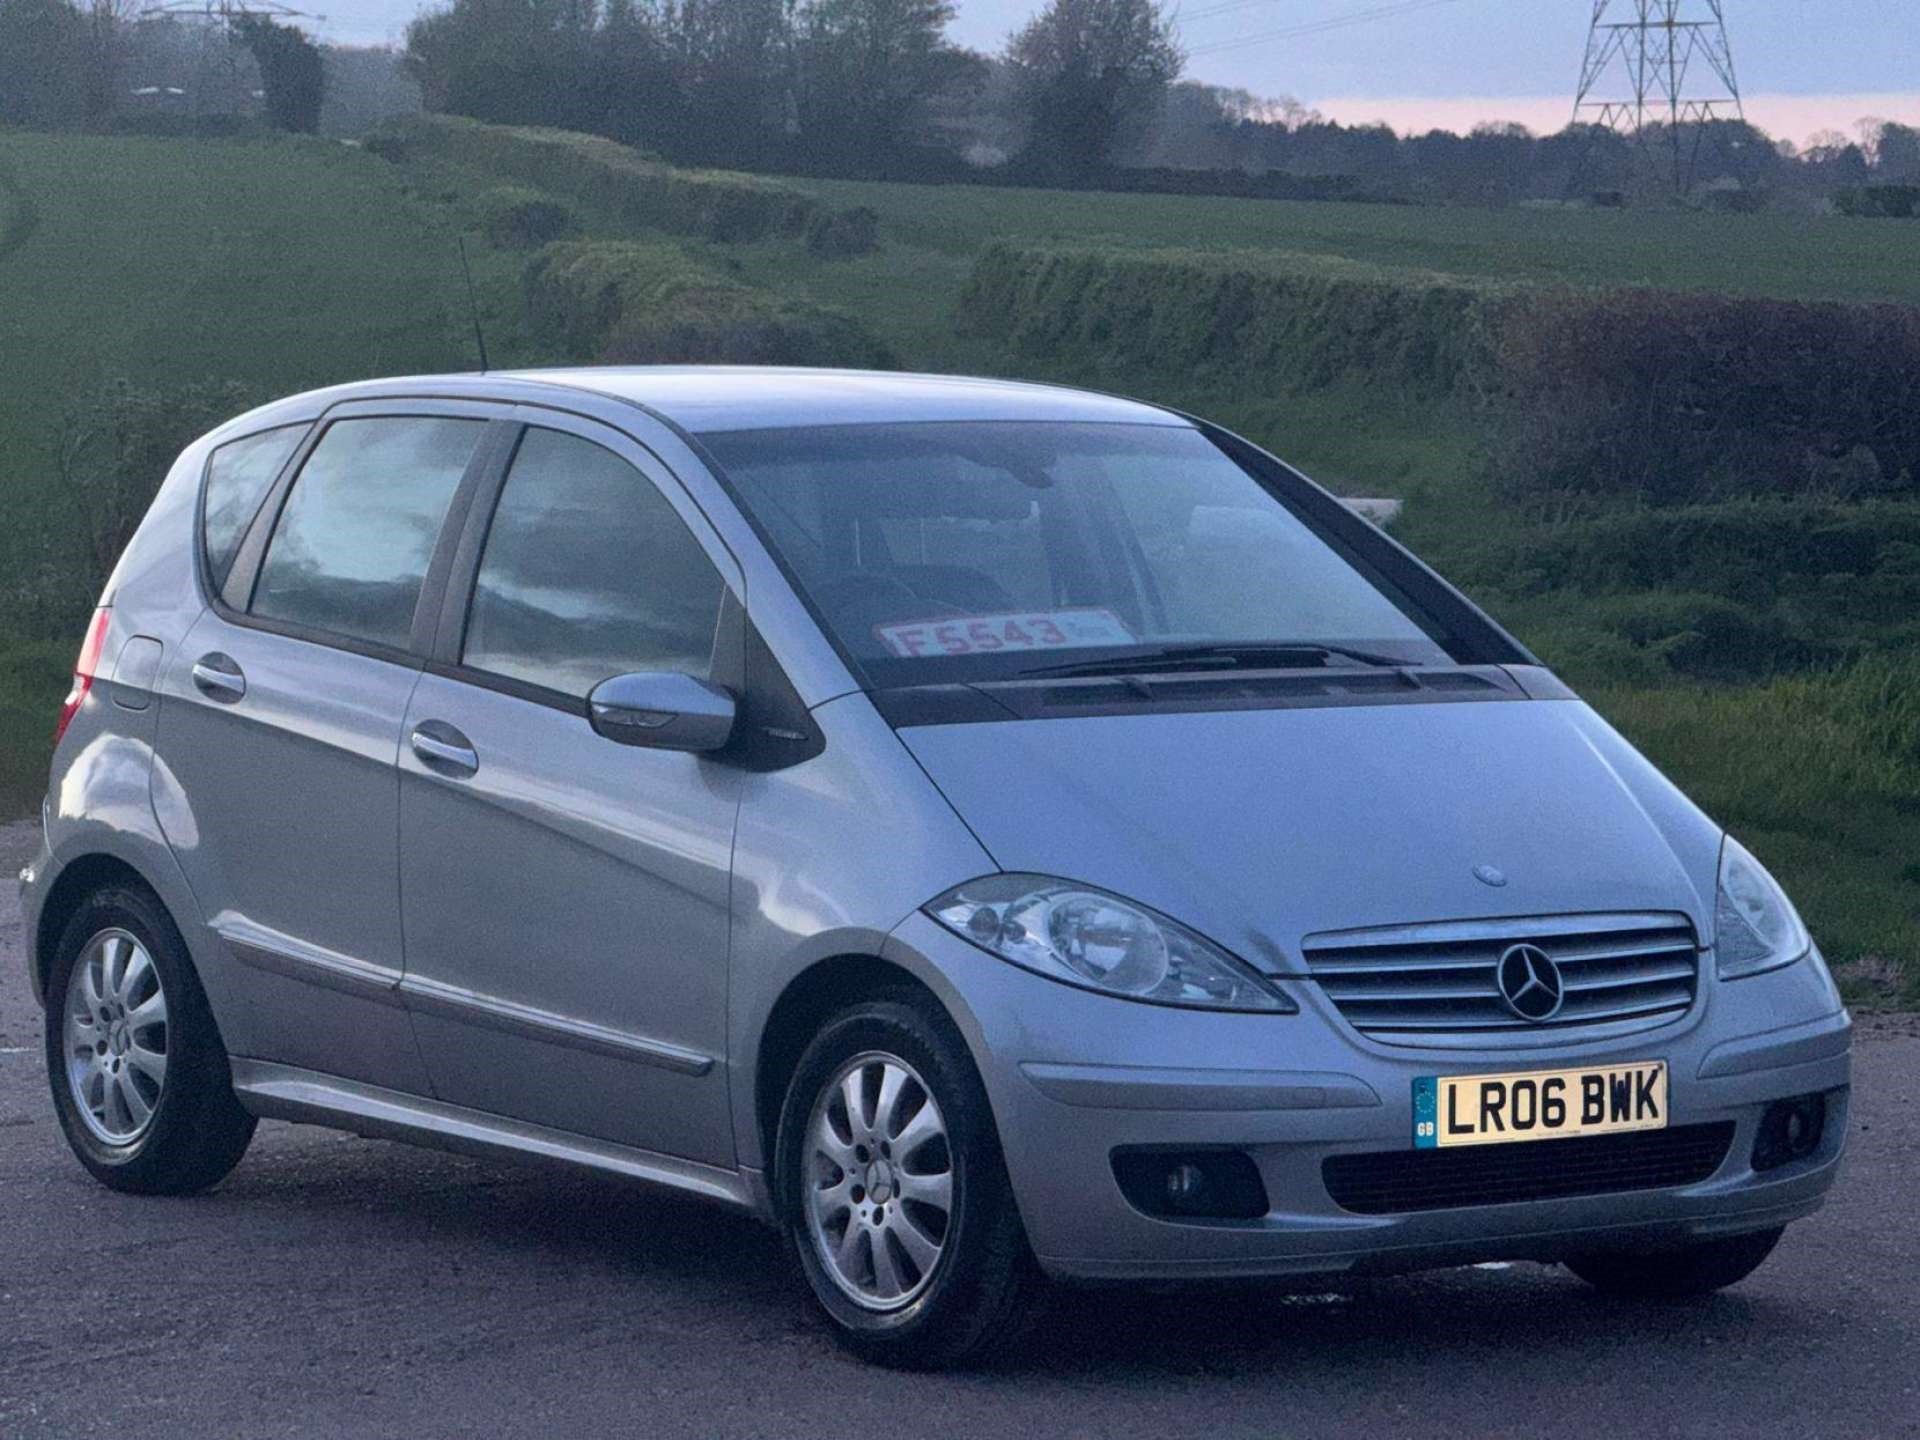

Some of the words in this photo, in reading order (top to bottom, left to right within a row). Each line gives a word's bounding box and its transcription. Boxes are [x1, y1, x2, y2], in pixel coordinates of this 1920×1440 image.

[1448, 1078, 1566, 1134] LR06
[1581, 1068, 1659, 1125] BWK
[1417, 1121, 1434, 1137] GB
